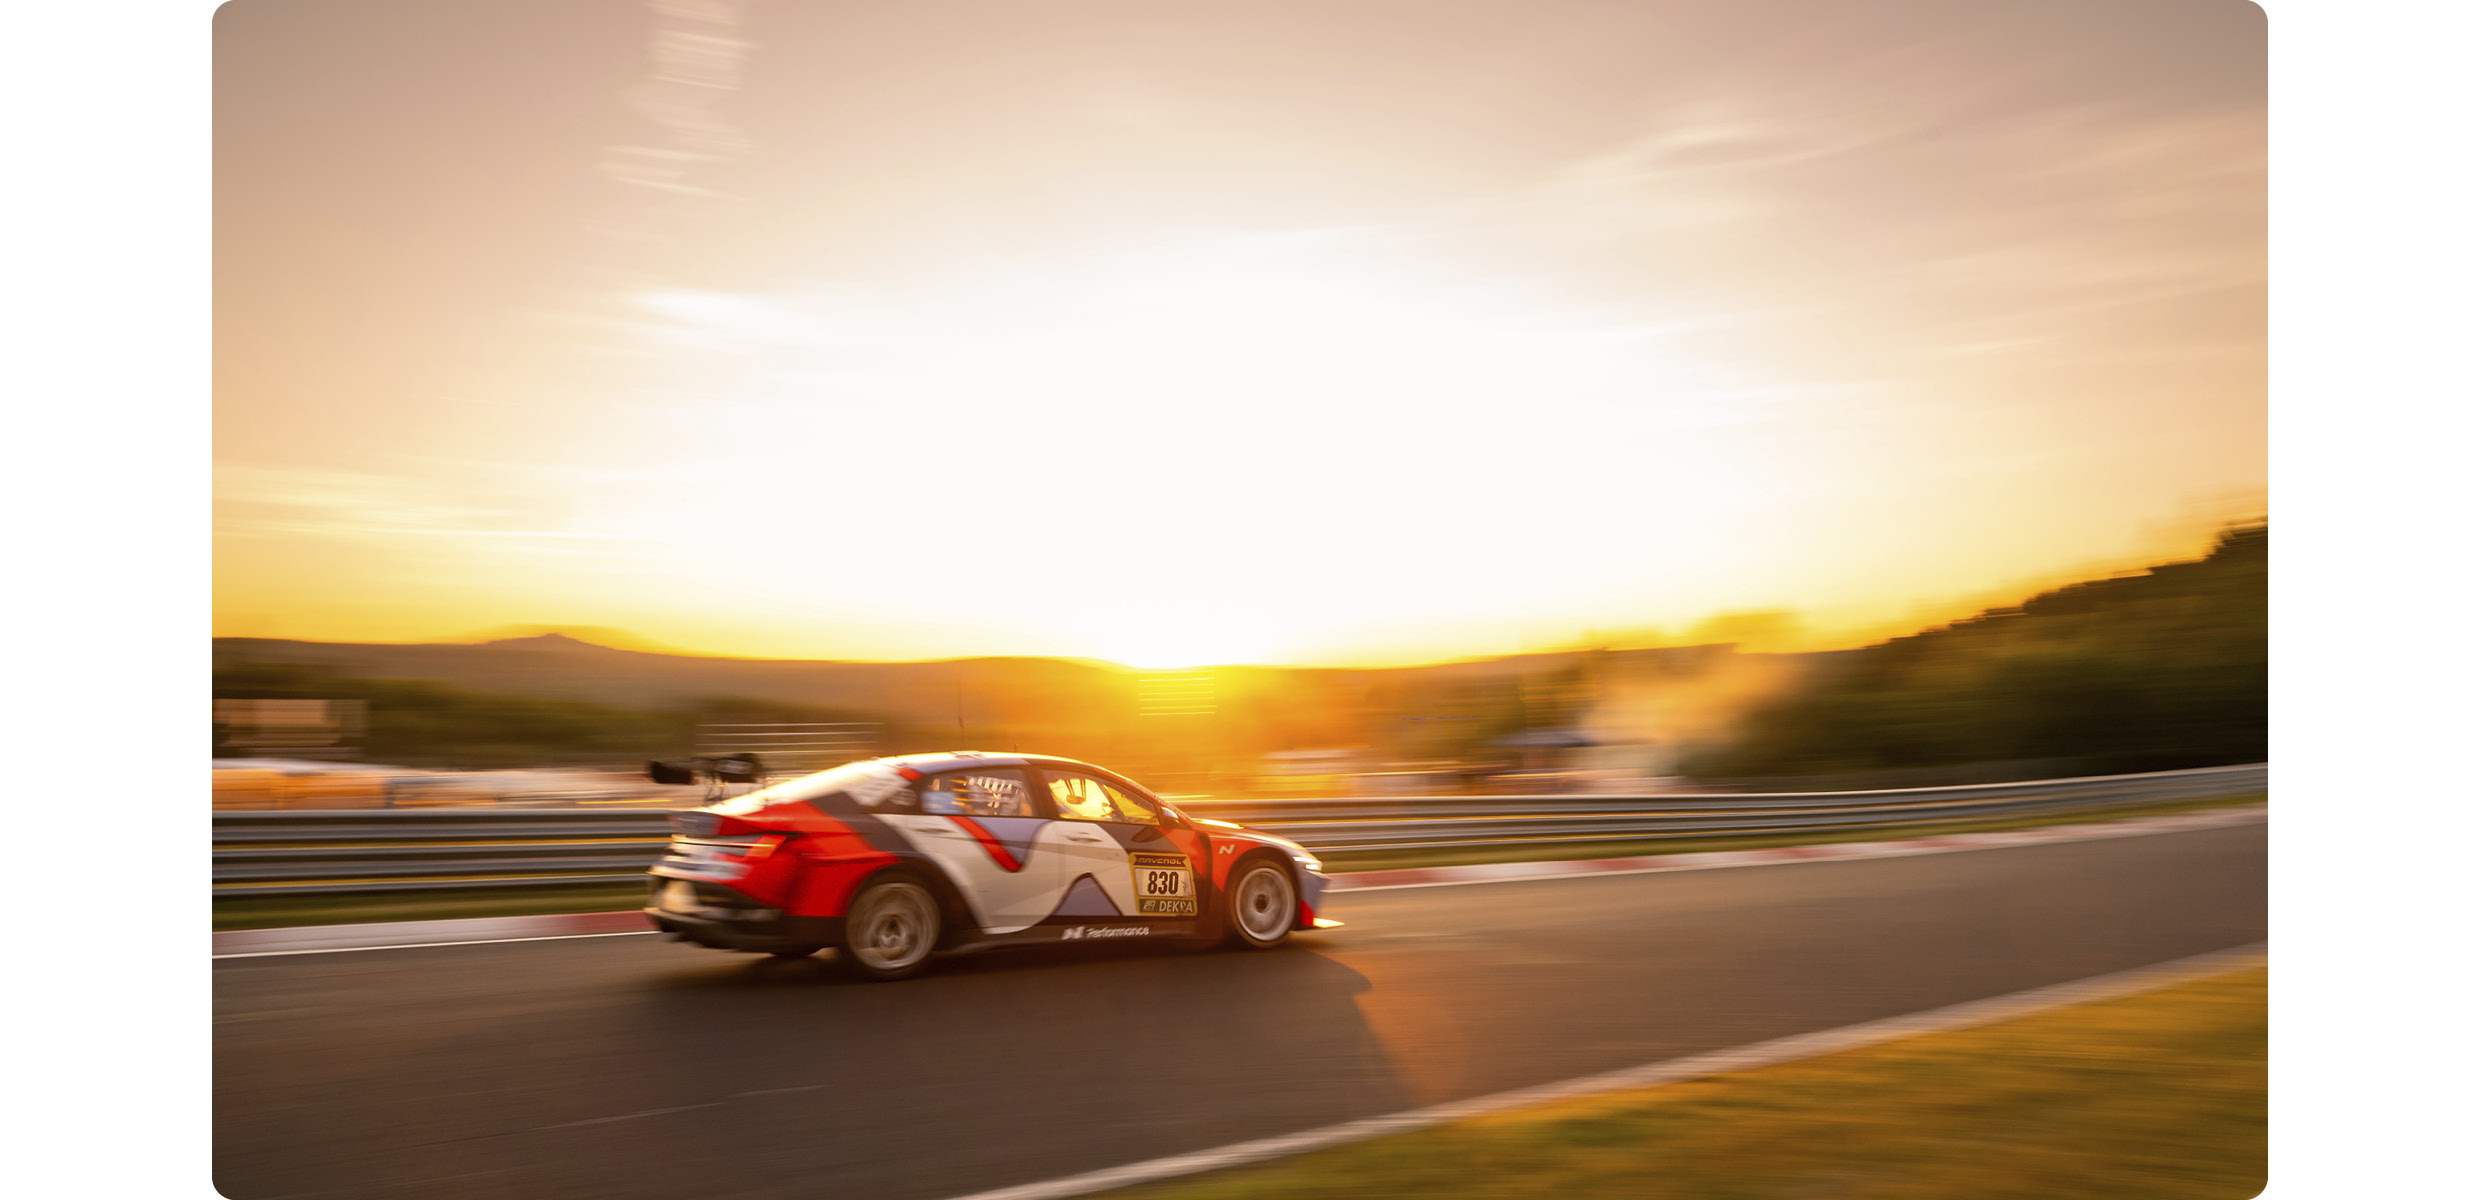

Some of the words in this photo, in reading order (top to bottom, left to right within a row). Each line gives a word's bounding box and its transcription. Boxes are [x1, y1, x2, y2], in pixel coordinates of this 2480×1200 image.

[1218, 845, 1236, 855] N
[1138, 857, 1182, 865] RAVENOL
[1147, 871, 1179, 895] 830
[1158, 901, 1193, 913] DEKRA
[1086, 926, 1150, 939] Performance
